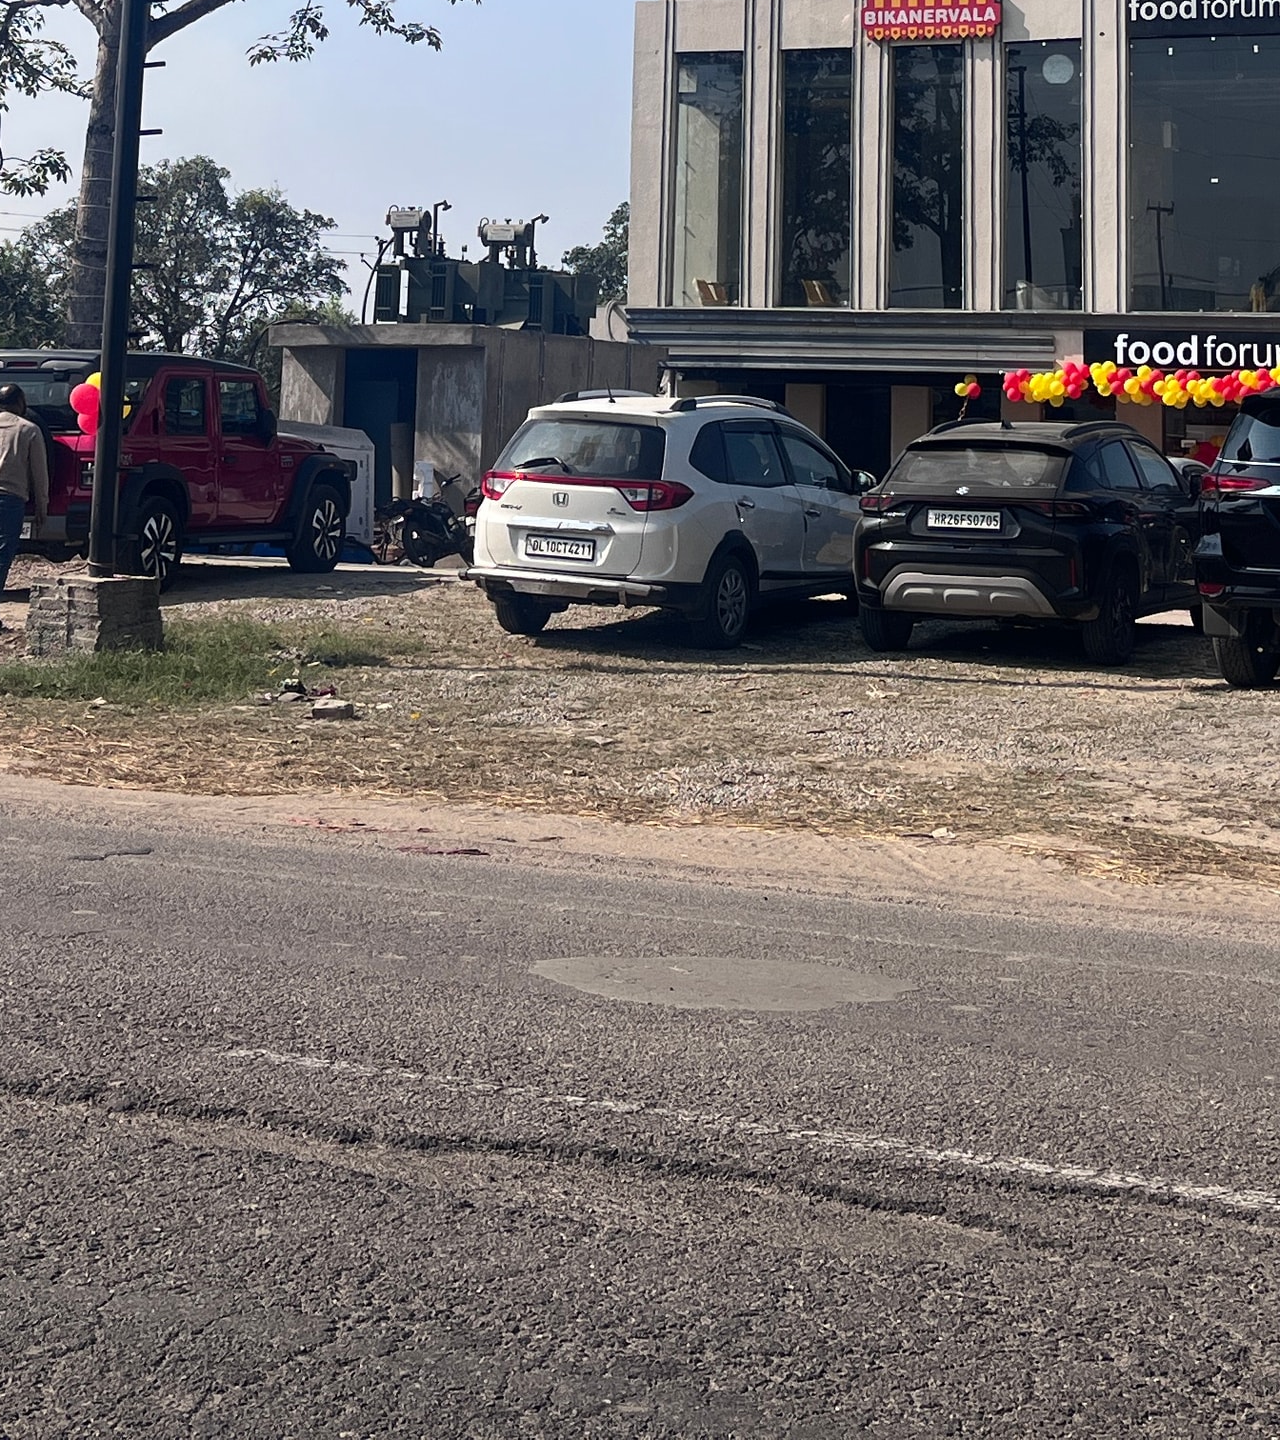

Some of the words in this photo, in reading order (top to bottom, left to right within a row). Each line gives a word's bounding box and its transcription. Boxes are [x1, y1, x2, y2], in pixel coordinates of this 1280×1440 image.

[864, 7, 996, 25] BIKANERVALA
[934, 512, 999, 527] HR26FS0705
[532, 539, 592, 556] DL10CT4211
